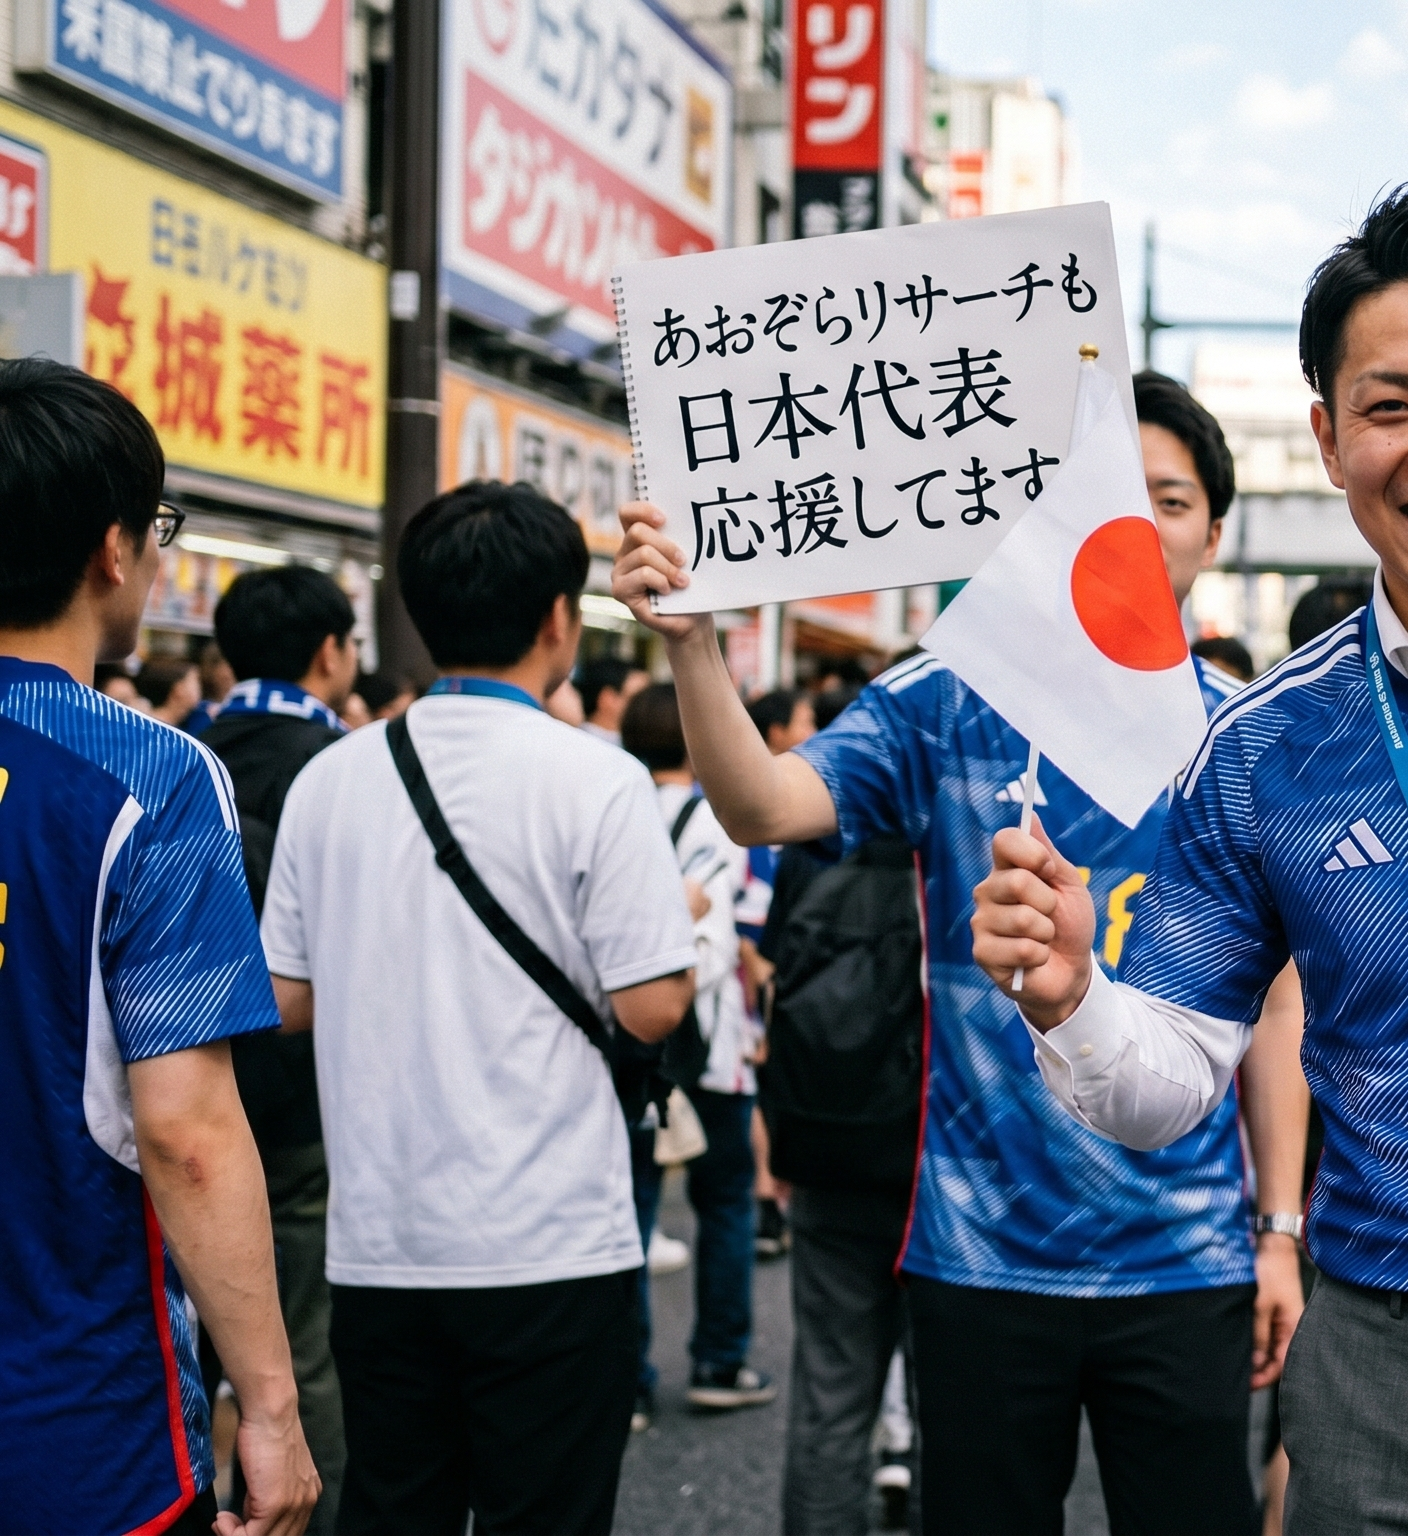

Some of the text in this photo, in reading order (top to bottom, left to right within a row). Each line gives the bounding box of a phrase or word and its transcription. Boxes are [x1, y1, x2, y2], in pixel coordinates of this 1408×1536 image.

[653, 252, 1098, 369] あおぞらリサーチも
[678, 347, 1018, 472] 日本代表
[690, 447, 1060, 572] 応援してます
